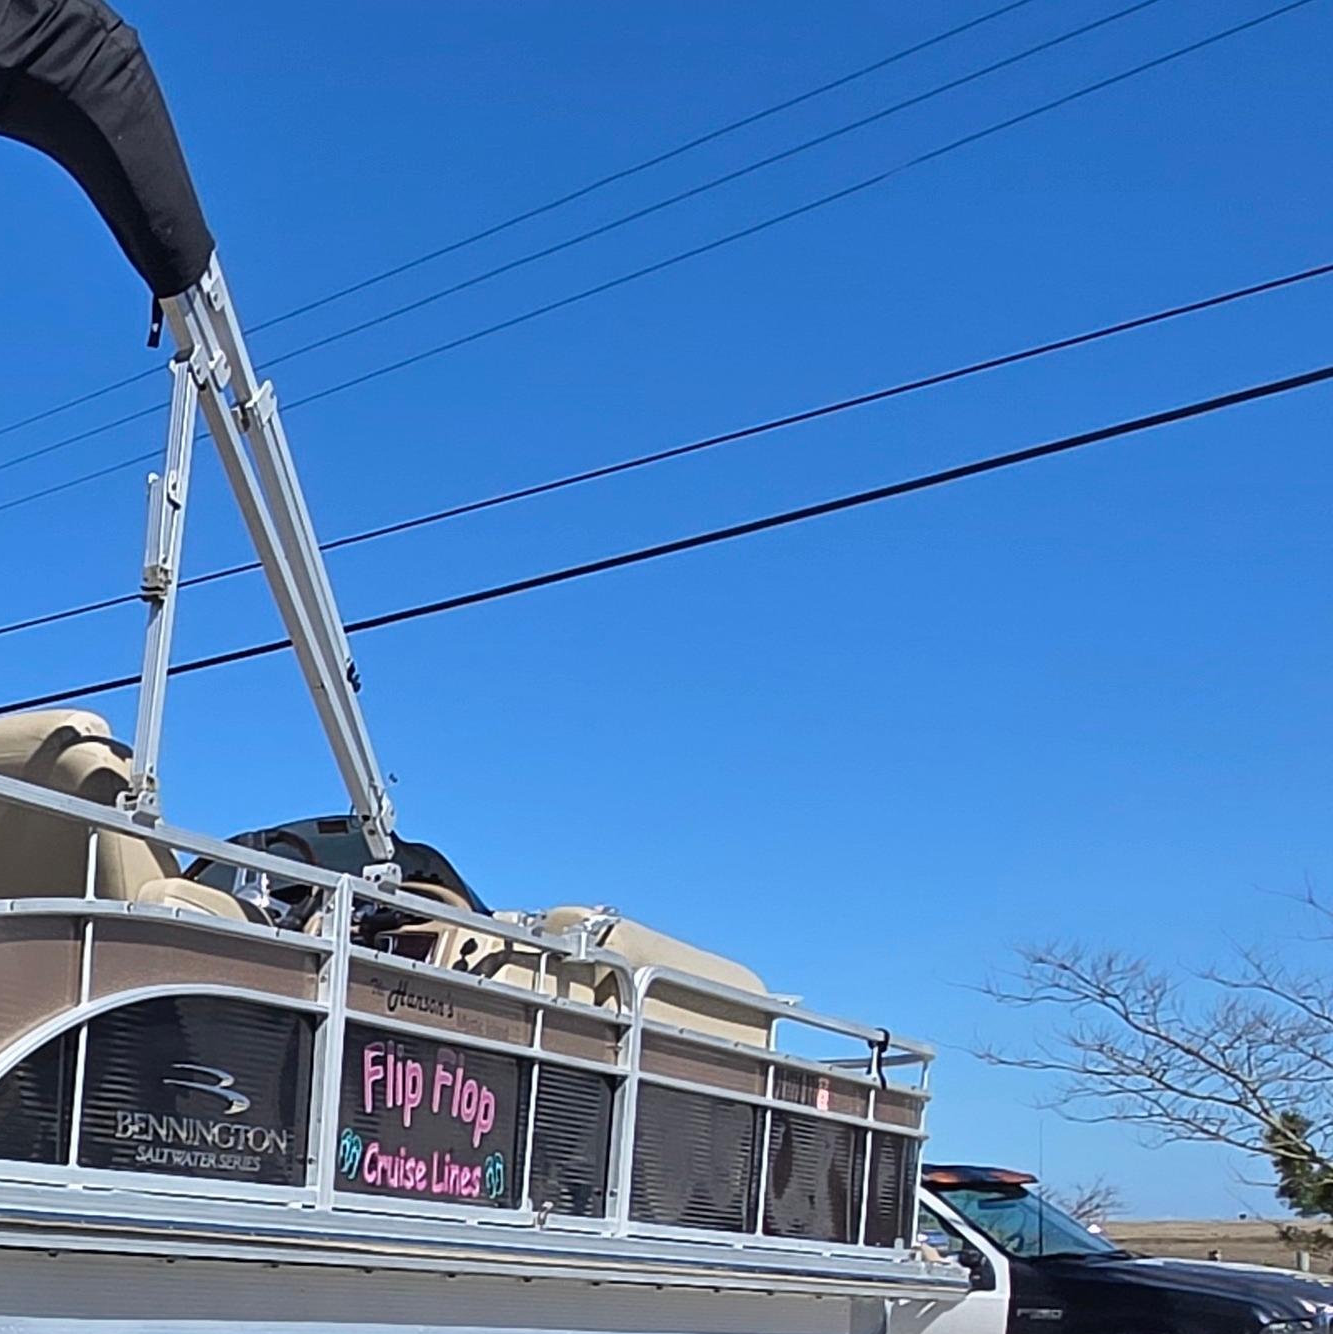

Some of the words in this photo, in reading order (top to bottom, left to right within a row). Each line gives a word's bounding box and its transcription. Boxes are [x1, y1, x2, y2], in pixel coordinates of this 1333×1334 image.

[363, 1041, 423, 1128] Flip
[432, 1048, 495, 1148] Flop
[115, 1110, 288, 1155] BENNINGTON
[363, 1141, 428, 1191] Cruise
[432, 1151, 482, 1197] Lines
